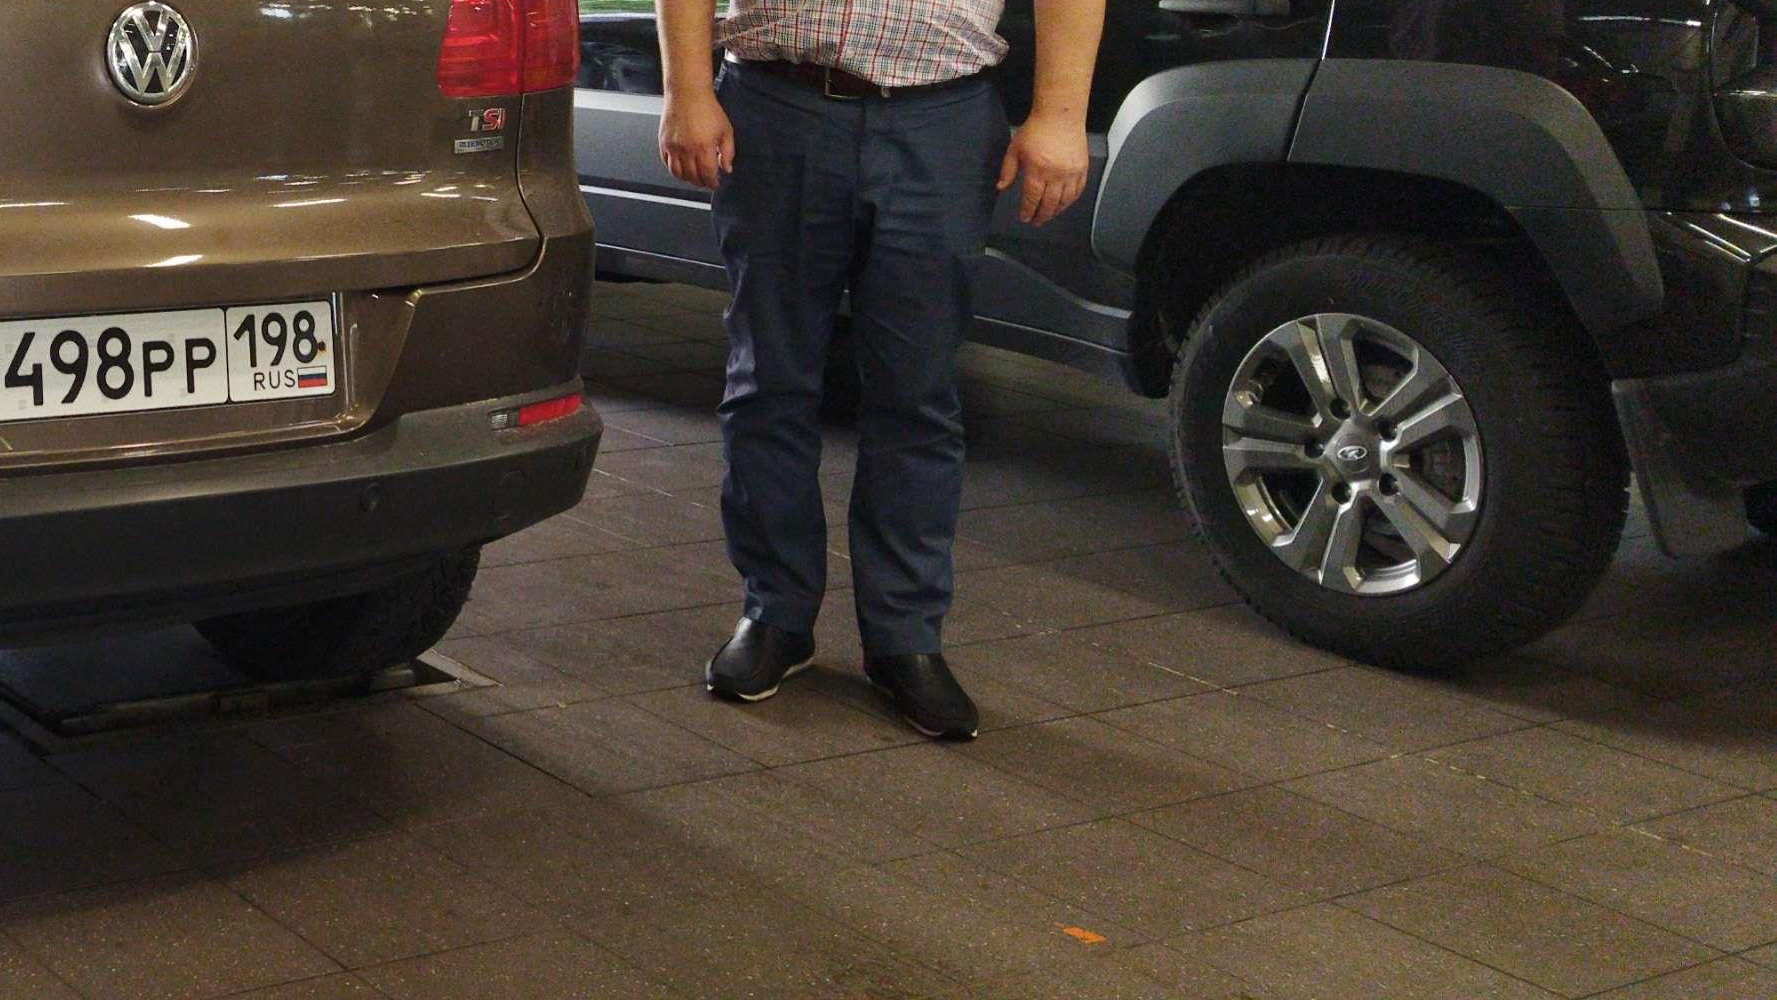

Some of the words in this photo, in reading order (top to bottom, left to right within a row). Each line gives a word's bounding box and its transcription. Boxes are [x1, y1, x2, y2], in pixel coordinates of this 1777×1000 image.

[468, 108, 508, 131] TSI
[233, 310, 317, 368] 198
[254, 368, 296, 391] RUS
